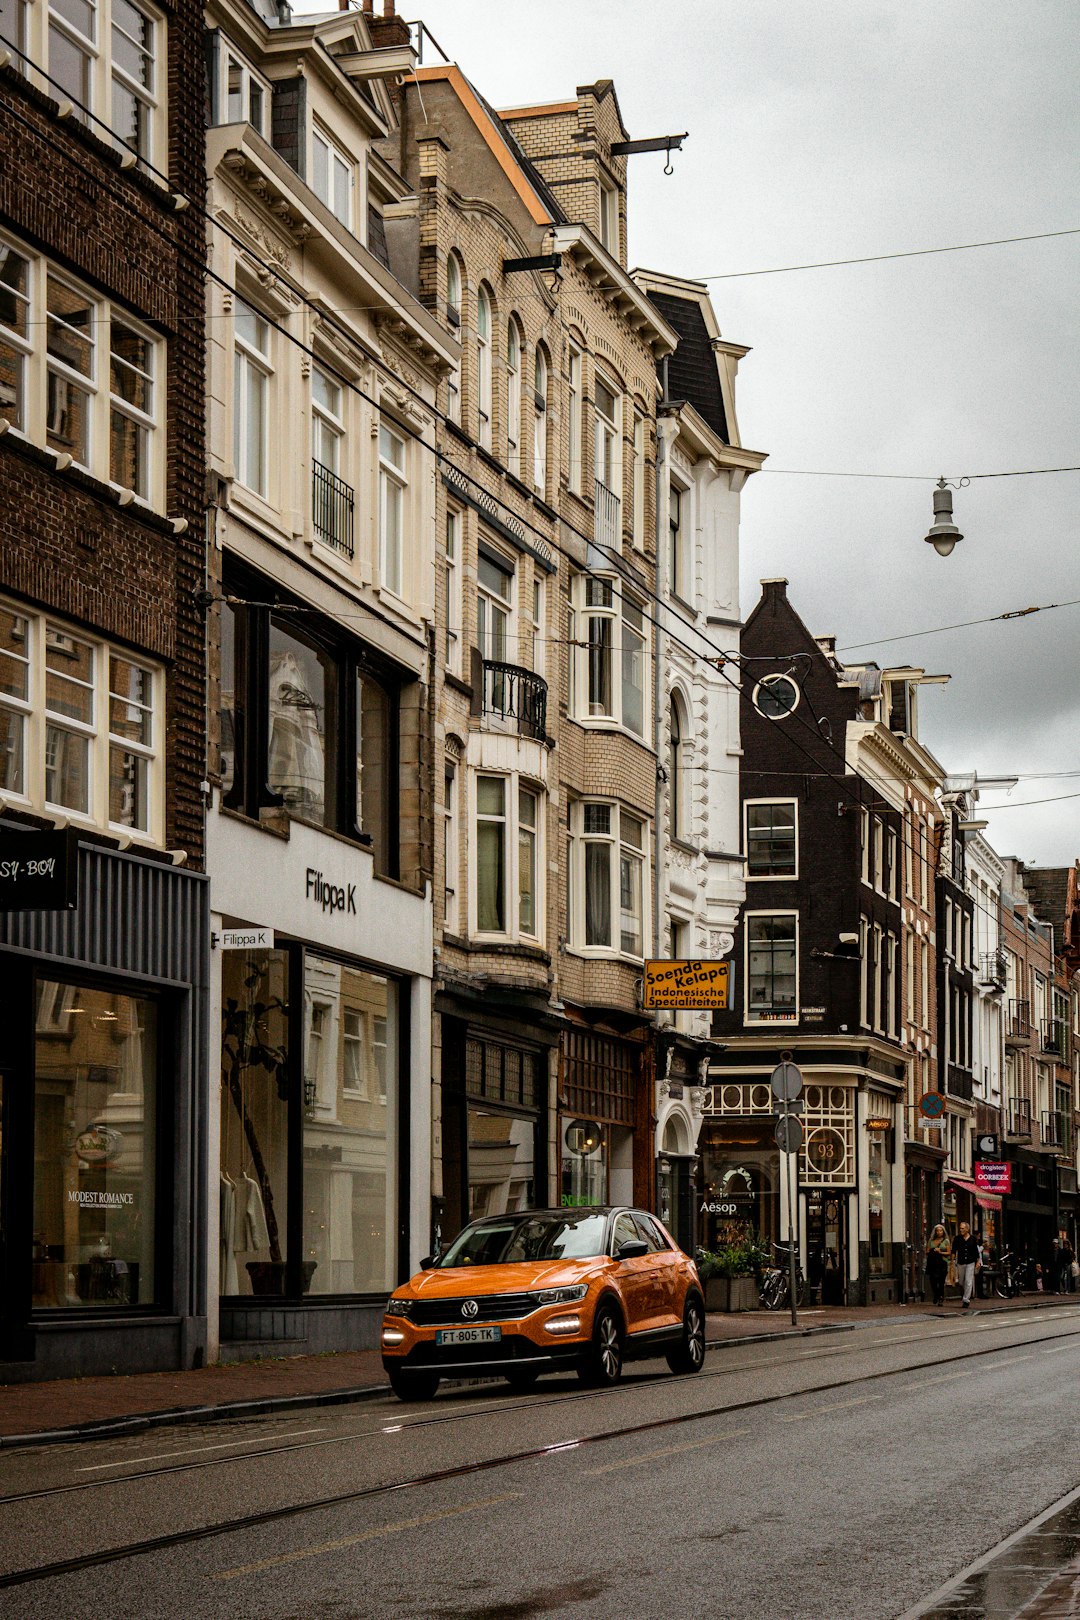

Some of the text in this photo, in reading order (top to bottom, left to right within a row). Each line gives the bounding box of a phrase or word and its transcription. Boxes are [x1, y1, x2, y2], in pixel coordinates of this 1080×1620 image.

[305, 867, 357, 916] Filippa K
[223, 932, 266, 947] Filippa K
[646, 961, 702, 985] Soenda
[675, 966, 728, 988] Kelapa
[651, 987, 724, 997] Indonesische
[648, 997, 724, 1008] Specialiteiten
[818, 1143, 834, 1158] 93
[68, 1191, 134, 1204] MODEST ROMANCE
[700, 1201, 737, 1215] Aēsop
[443, 1329, 493, 1342] FT-805-TK
